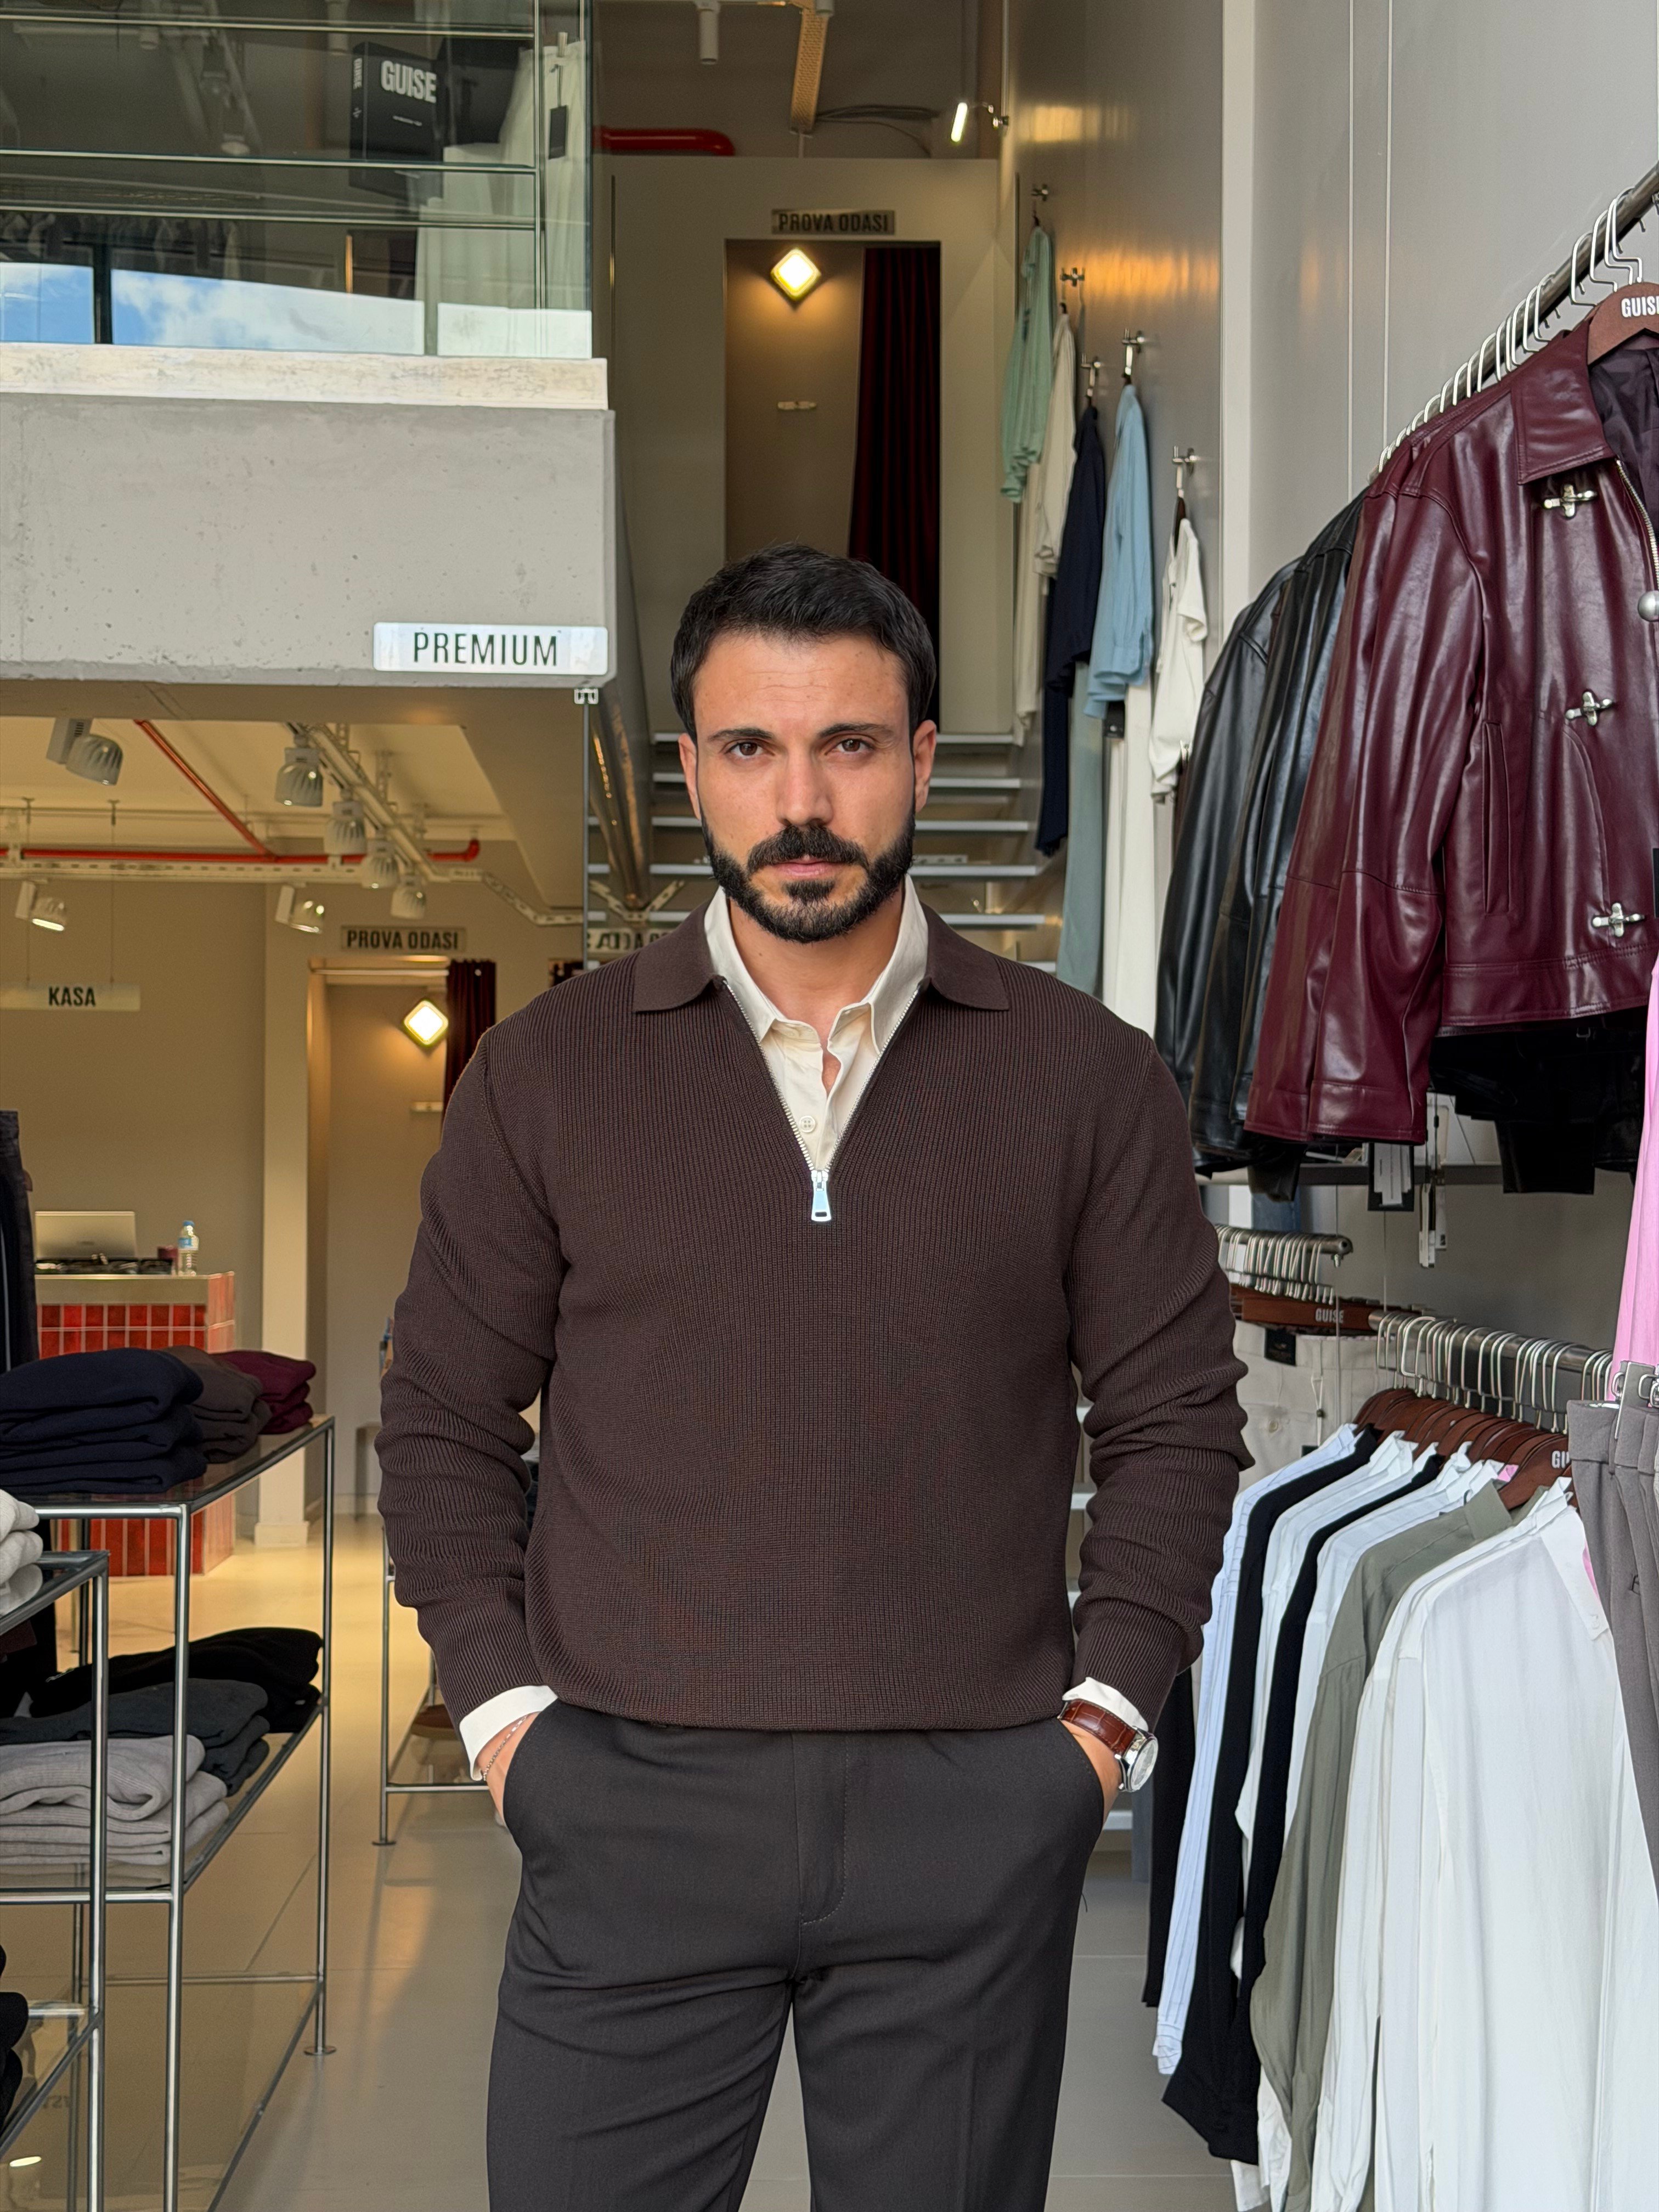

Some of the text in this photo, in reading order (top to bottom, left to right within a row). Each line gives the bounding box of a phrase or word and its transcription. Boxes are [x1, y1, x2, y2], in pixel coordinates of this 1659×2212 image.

[381, 60, 437, 103] GUISE
[779, 213, 888, 232] PROVA ODASI
[414, 631, 557, 667] PREMIUM
[347, 930, 458, 950] PROVA ODASI
[48, 986, 96, 1006] KASA
